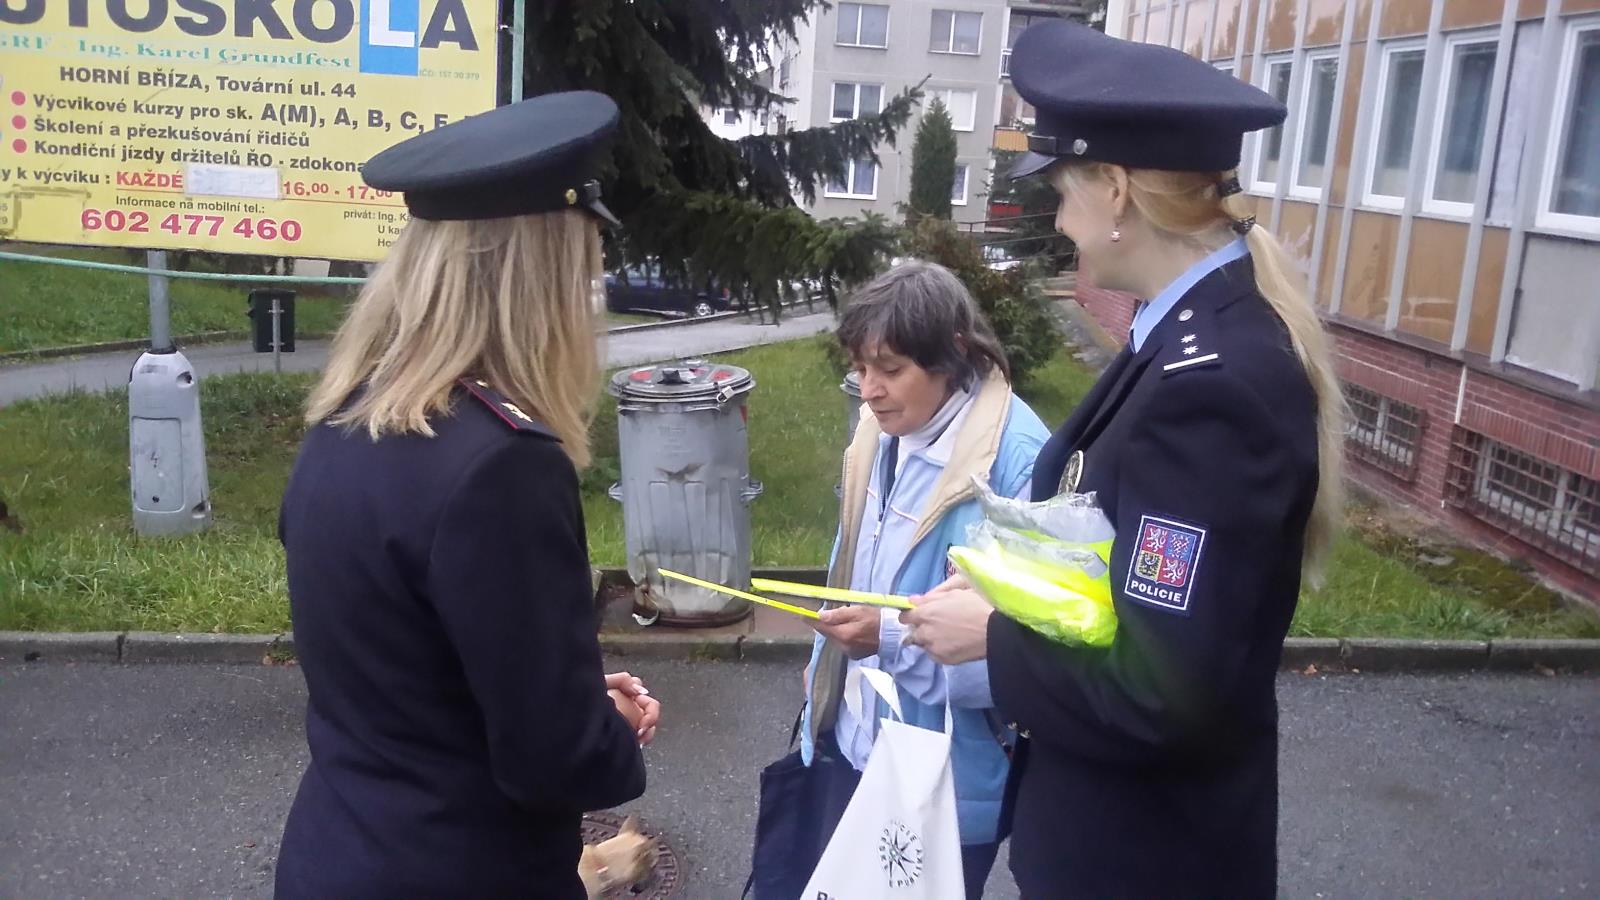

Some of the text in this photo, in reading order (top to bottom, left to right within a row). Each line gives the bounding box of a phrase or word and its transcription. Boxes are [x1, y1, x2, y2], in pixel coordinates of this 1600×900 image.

[79, 39, 129, 57] Ing.
[137, 43, 210, 60] Karel
[218, 47, 352, 68] Grundfest
[59, 64, 356, 98] HORNÍ BŘÍZA, Tovární ul. 44
[33, 93, 127, 113] Výcvikové
[133, 99, 184, 120] kurzy
[190, 106, 220, 120] pro
[226, 105, 253, 120] sk.
[260, 102, 326, 128] A(M),
[333, 107, 358, 129] A,
[367, 109, 391, 131] B,
[400, 111, 424, 134] C,
[33, 114, 310, 147] Školení a přezkušování řidičů
[34, 140, 115, 158] Kondiční
[121, 147, 164, 164] jízdy
[170, 148, 241, 166] držitelů
[247, 149, 272, 167] ŘO
[17, 167, 27, 180] k
[33, 168, 100, 184] výcviku
[116, 169, 183, 189] KAŽDÉ
[116, 195, 265, 214] Informace na mobilní tel.:
[343, 208, 376, 219] privát:
[378, 211, 397, 223] Ing.
[81, 208, 302, 242] 602 477 460
[378, 225, 403, 235] U ka
[377, 238, 394, 247] Ho
[1130, 580, 1183, 603] POLICIE
